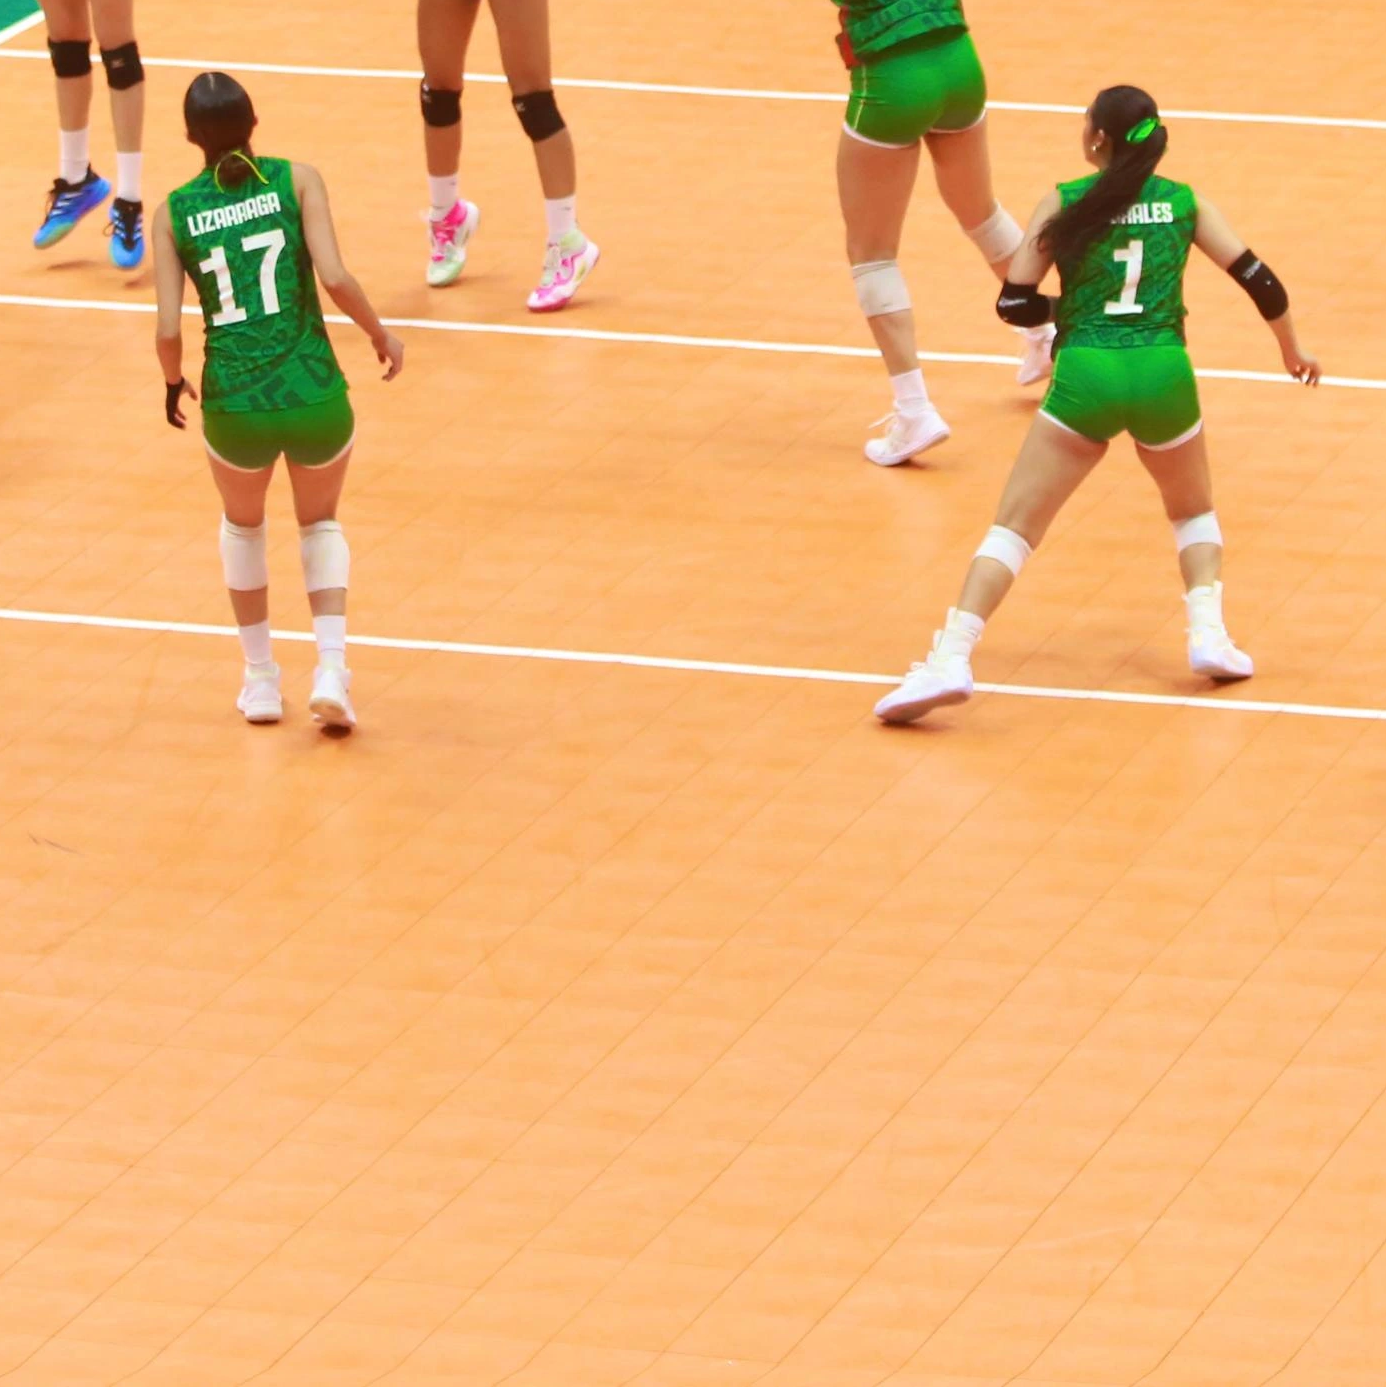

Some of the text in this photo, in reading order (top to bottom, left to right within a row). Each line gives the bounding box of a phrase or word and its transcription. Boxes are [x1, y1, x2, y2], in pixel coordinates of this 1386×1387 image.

[187, 192, 281, 237] LIZARRAGA
[199, 228, 286, 327] 17
[1104, 240, 1144, 315] 1
